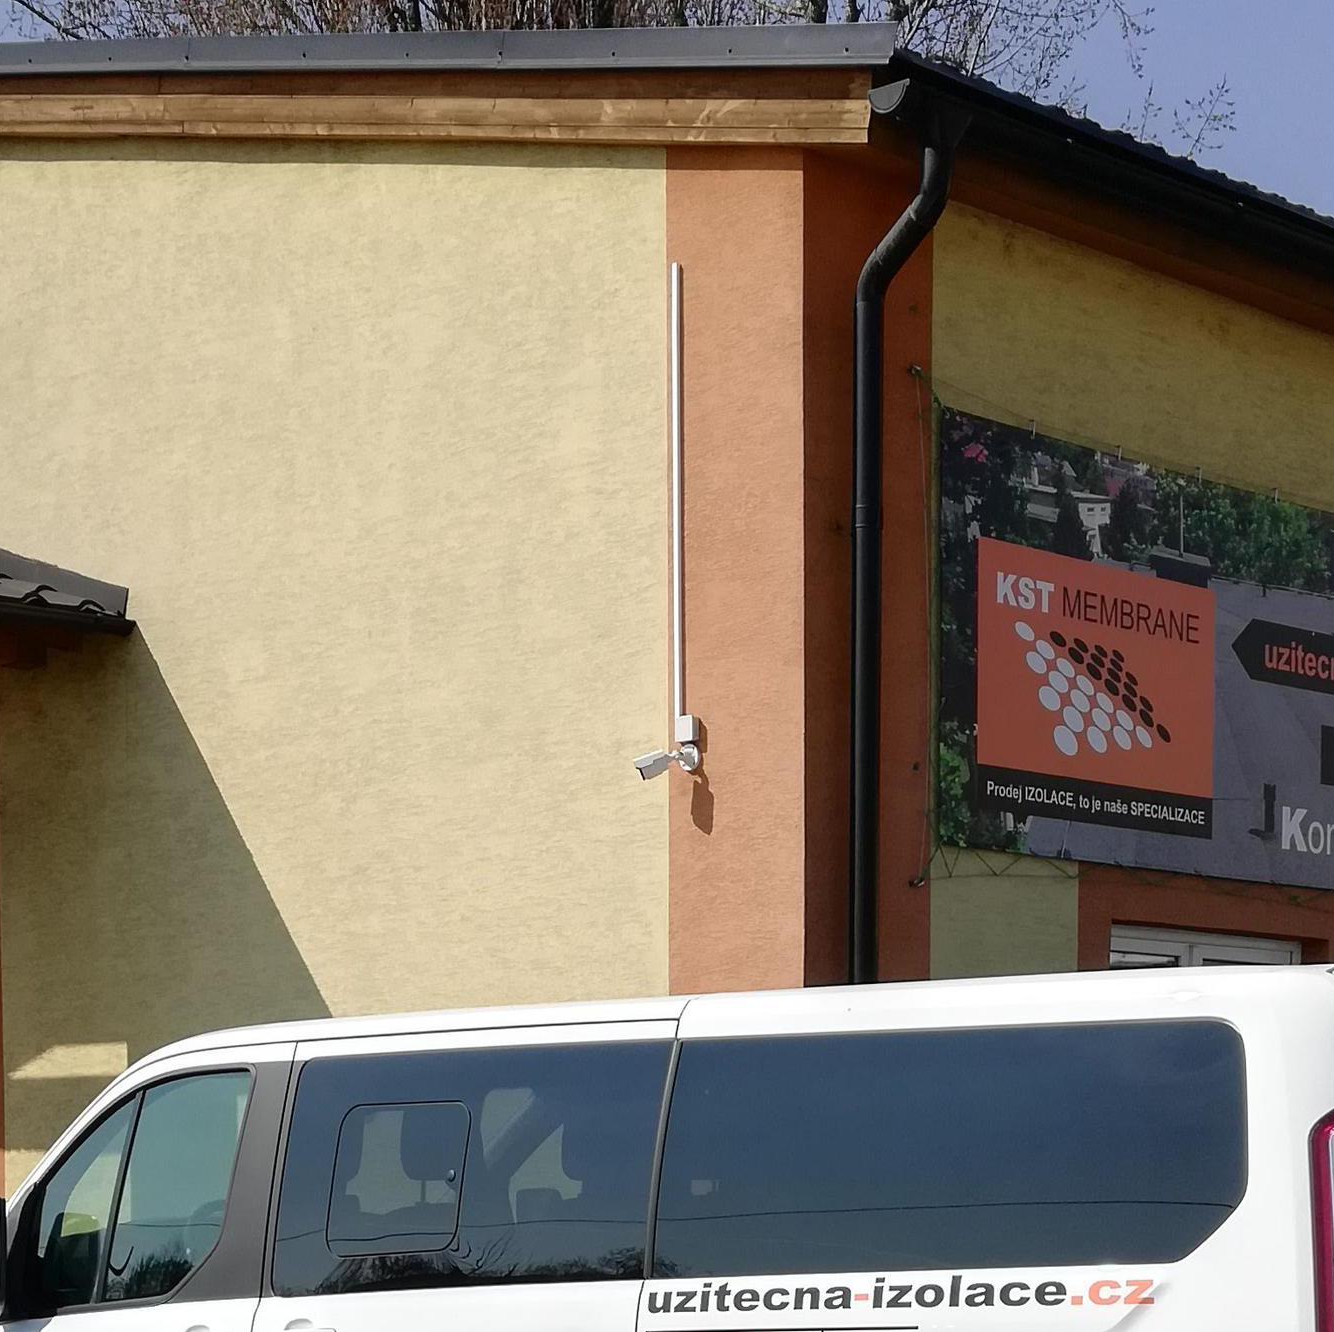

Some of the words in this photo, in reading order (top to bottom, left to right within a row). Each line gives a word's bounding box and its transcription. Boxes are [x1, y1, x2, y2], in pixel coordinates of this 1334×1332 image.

[996, 571, 1055, 614] KST
[1062, 586, 1200, 645] MEMBRANE
[986, 780, 1023, 803] Prodej
[1025, 786, 1076, 810] IZOLACE,
[1079, 794, 1090, 809] to
[1091, 795, 1102, 813] je
[1104, 797, 1129, 815] naše
[1130, 801, 1206, 826] SPECIALIZACE
[647, 1275, 1155, 1314] uzitecna-izolace.cz
